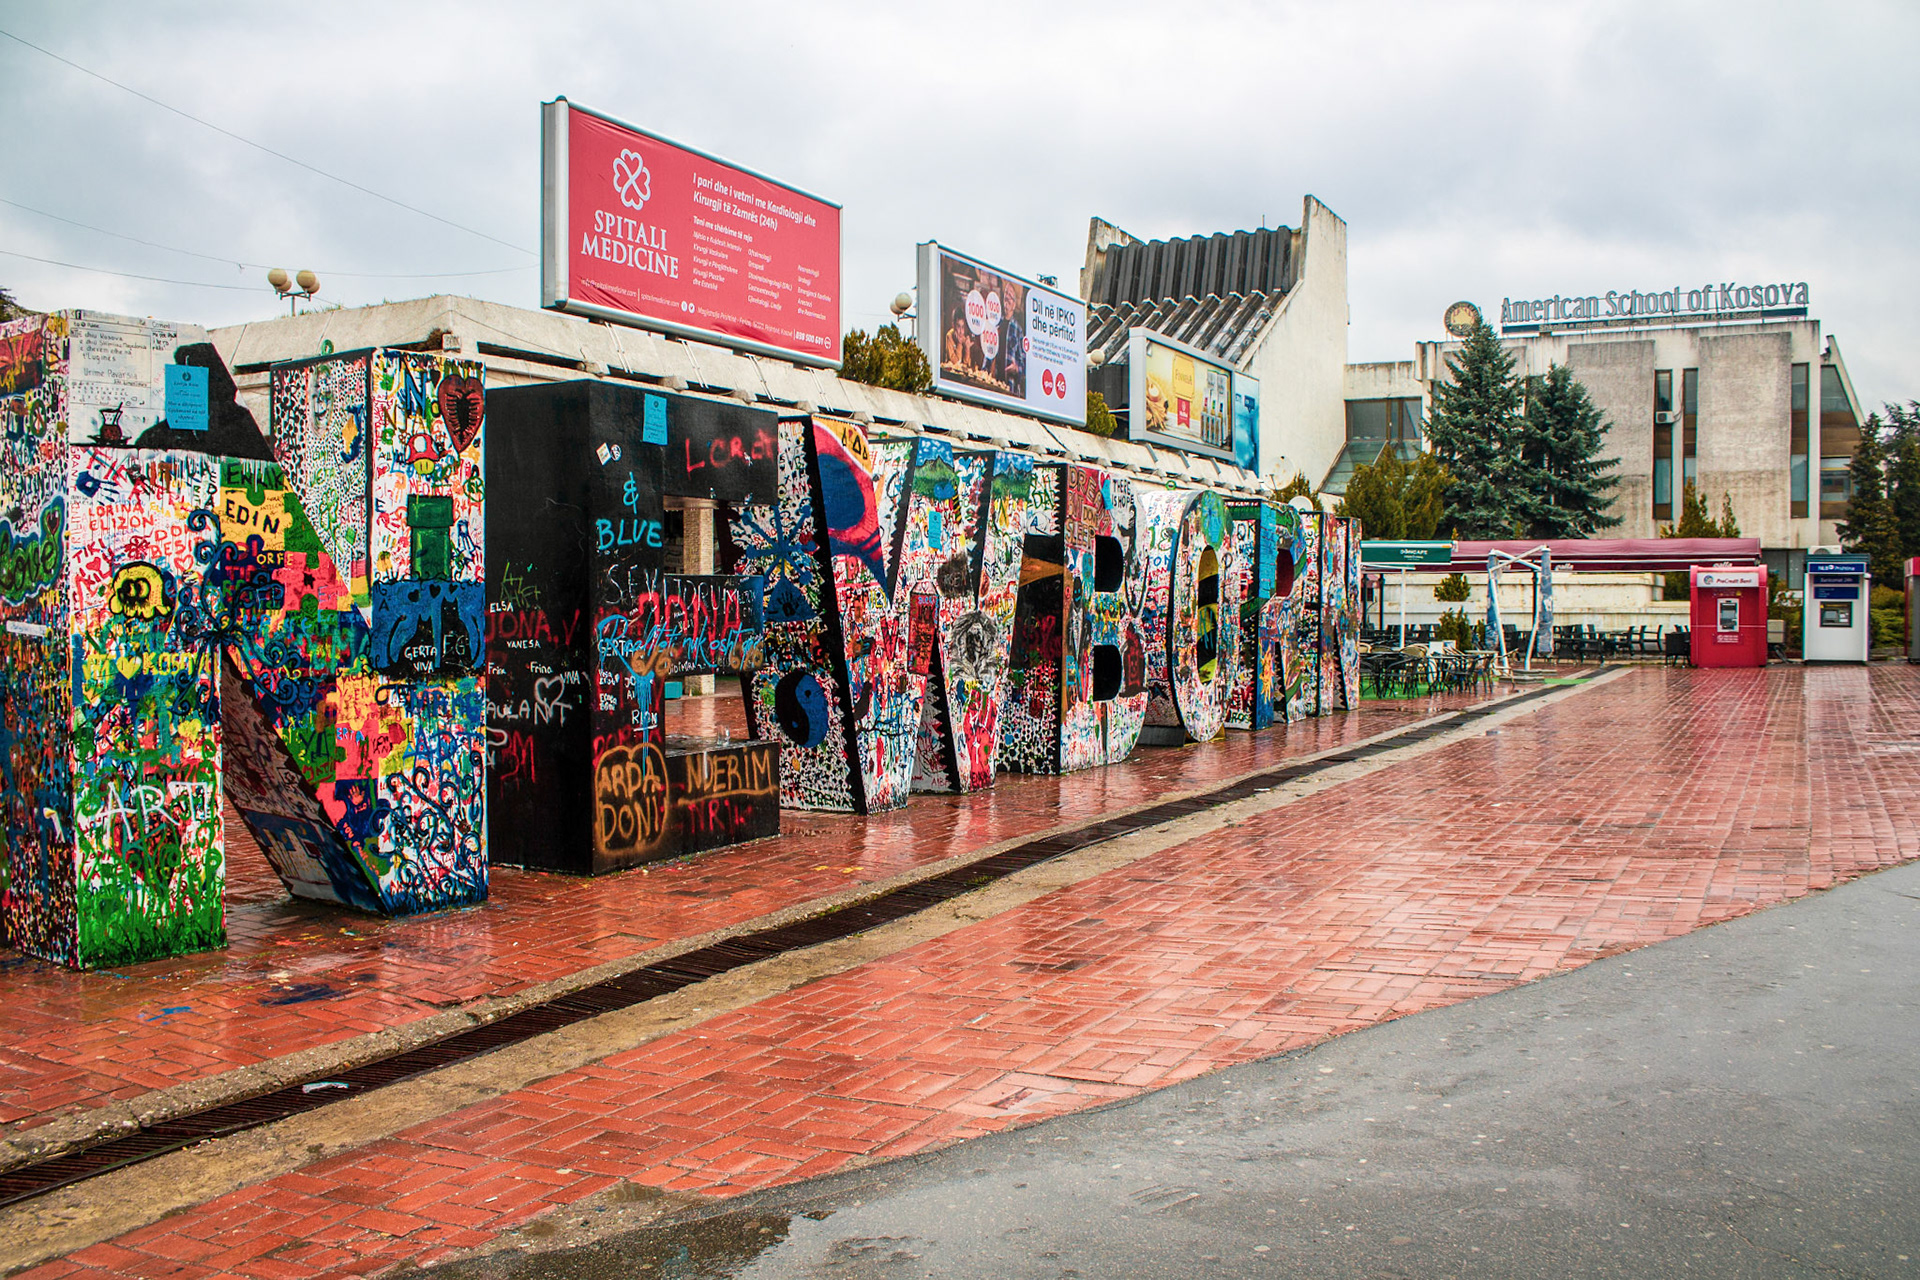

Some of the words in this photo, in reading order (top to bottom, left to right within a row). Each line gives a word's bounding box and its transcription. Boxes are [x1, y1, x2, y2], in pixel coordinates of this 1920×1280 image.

[693, 172, 696, 184] I
[698, 177, 713, 189] pari
[714, 181, 728, 195] dhe
[729, 186, 732, 196] i
[734, 190, 754, 204] vetmi
[755, 198, 766, 210] me
[767, 200, 803, 224] Kardiologji
[804, 215, 816, 228] dhe
[694, 191, 722, 212] Kirurgji
[723, 202, 731, 214] të
[732, 205, 758, 224] Zemrës
[760, 214, 778, 232] (24h)
[594, 209, 668, 251] SPITALI
[694, 216, 704, 226] Tani
[706, 221, 714, 230] me
[580, 231, 679, 279] MEDICINE
[968, 302, 984, 318] 1000
[1032, 298, 1042, 314] Dil
[1044, 306, 1054, 320] në
[1056, 306, 1076, 327] IPKO
[1501, 294, 1599, 323] American
[1605, 287, 1680, 318] School
[1688, 284, 1713, 312] of
[1720, 282, 1810, 310] Kosova
[1732, 310, 1760, 318] School
[983, 330, 997, 346] 1000
[1032, 318, 1048, 332] dhe
[1049, 322, 1076, 344] përfito!
[88, 503, 144, 517] LORINA
[226, 499, 280, 534] EDIN
[596, 518, 662, 550] BLUE
[256, 554, 294, 566] ORFE
[490, 600, 514, 613] ELSA
[404, 646, 438, 660] GERTA
[600, 756, 662, 798] ARDA
[95, 780, 208, 842] ART
